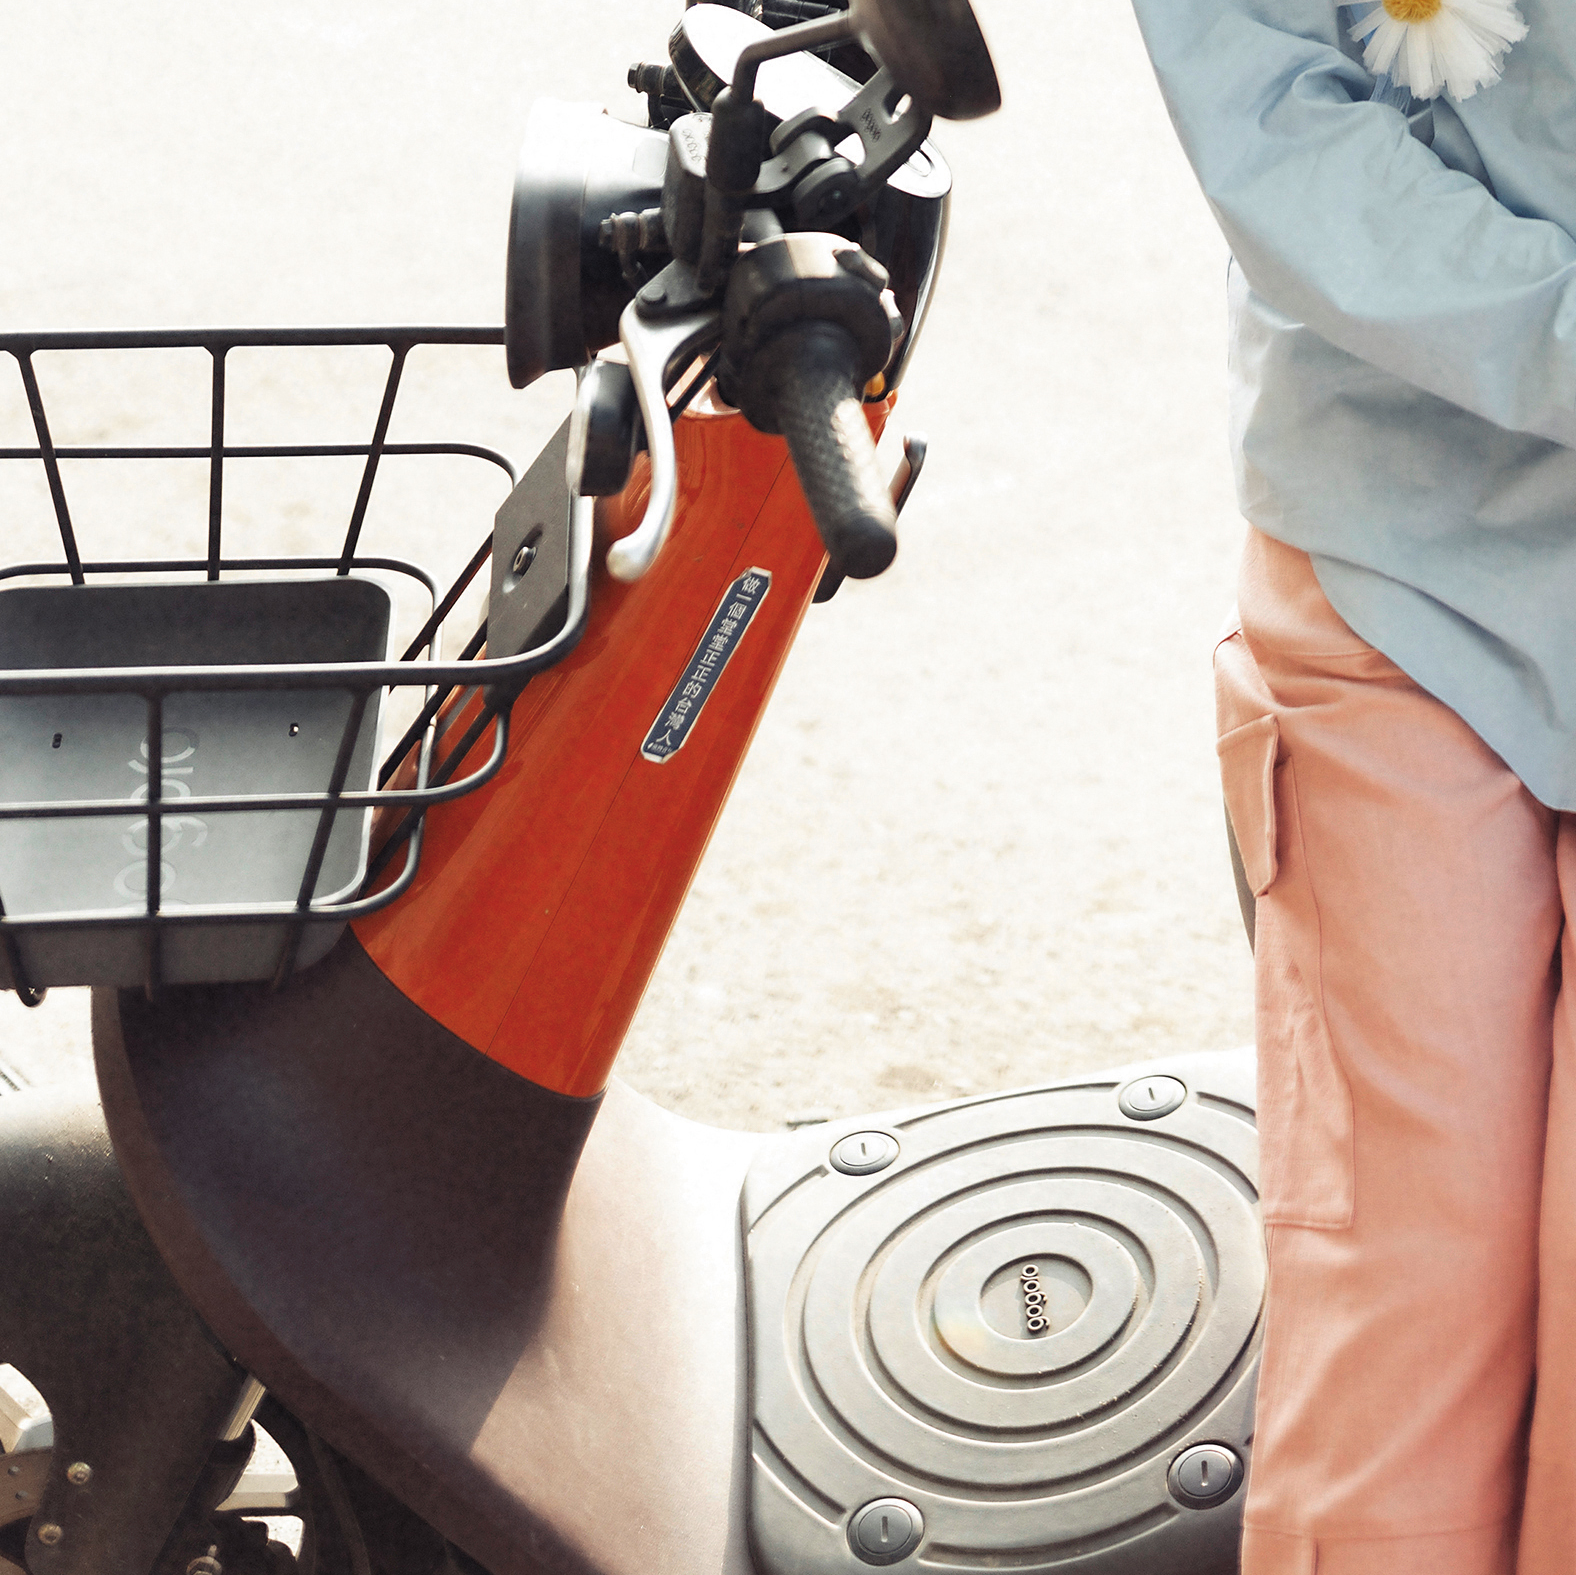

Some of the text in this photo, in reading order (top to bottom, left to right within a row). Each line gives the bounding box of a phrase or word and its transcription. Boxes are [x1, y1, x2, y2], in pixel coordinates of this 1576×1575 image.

[655, 576, 762, 746] 做一個堂堂正正的台灣人
[113, 726, 208, 909] ogoro
[1020, 1264, 1050, 1331] gogoro
